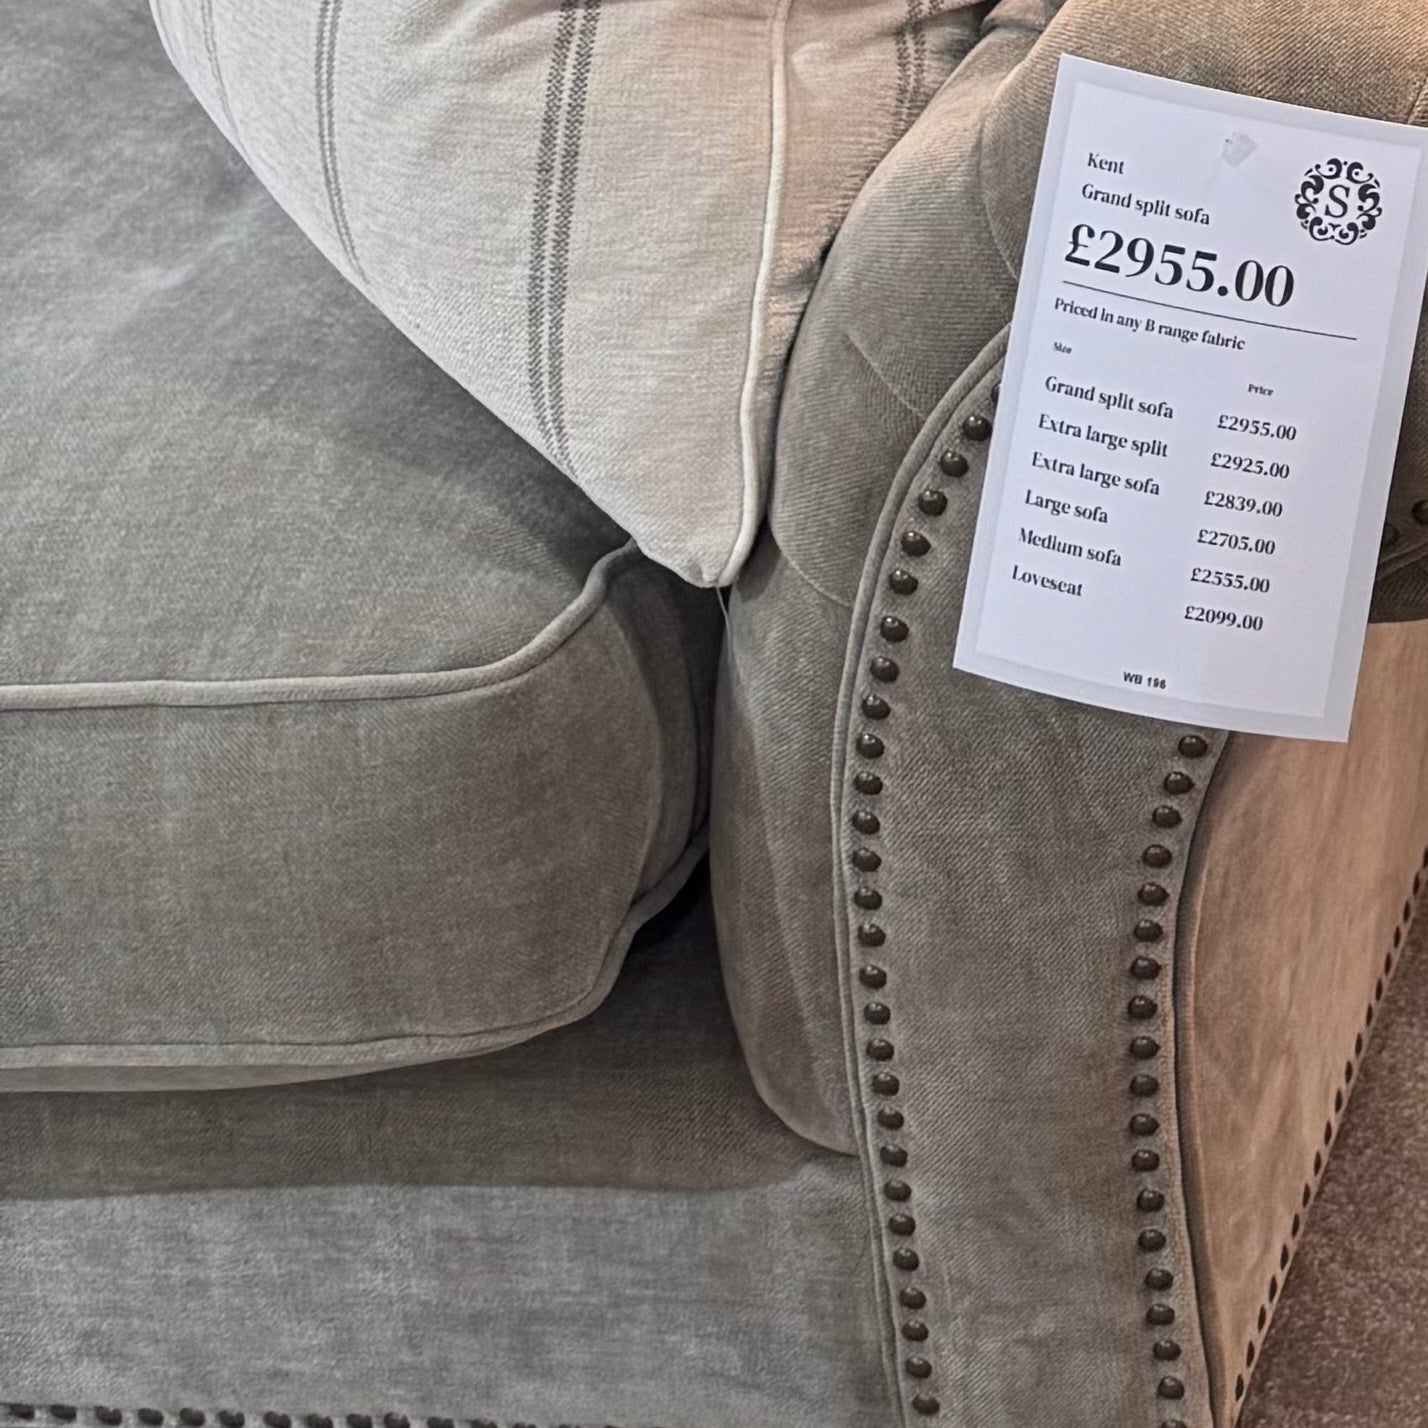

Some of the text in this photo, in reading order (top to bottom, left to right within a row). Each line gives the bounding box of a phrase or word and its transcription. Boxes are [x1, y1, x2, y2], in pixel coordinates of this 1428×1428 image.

[1086, 151, 1124, 175] Kent
[1081, 182, 1210, 225] Grand split sofa
[1063, 222, 1295, 307] £2955.00
[1053, 296, 1246, 350] Priced in any B range fabric
[1044, 375, 1173, 419] Grand split sofa
[1037, 412, 1168, 458] Extra large split
[1216, 414, 1297, 441] £2955.00
[1031, 450, 1160, 496] Extra large sofa
[1209, 451, 1290, 479] £2925.00
[1024, 488, 1108, 524] Large sofa
[1203, 490, 1283, 517] £2839.00
[1019, 526, 1121, 566] Medium sofa
[1196, 528, 1276, 555] £2705.00
[1011, 564, 1083, 597] Loveseat
[1189, 566, 1270, 593] £2555.00
[1183, 605, 1264, 631] £2099.00
